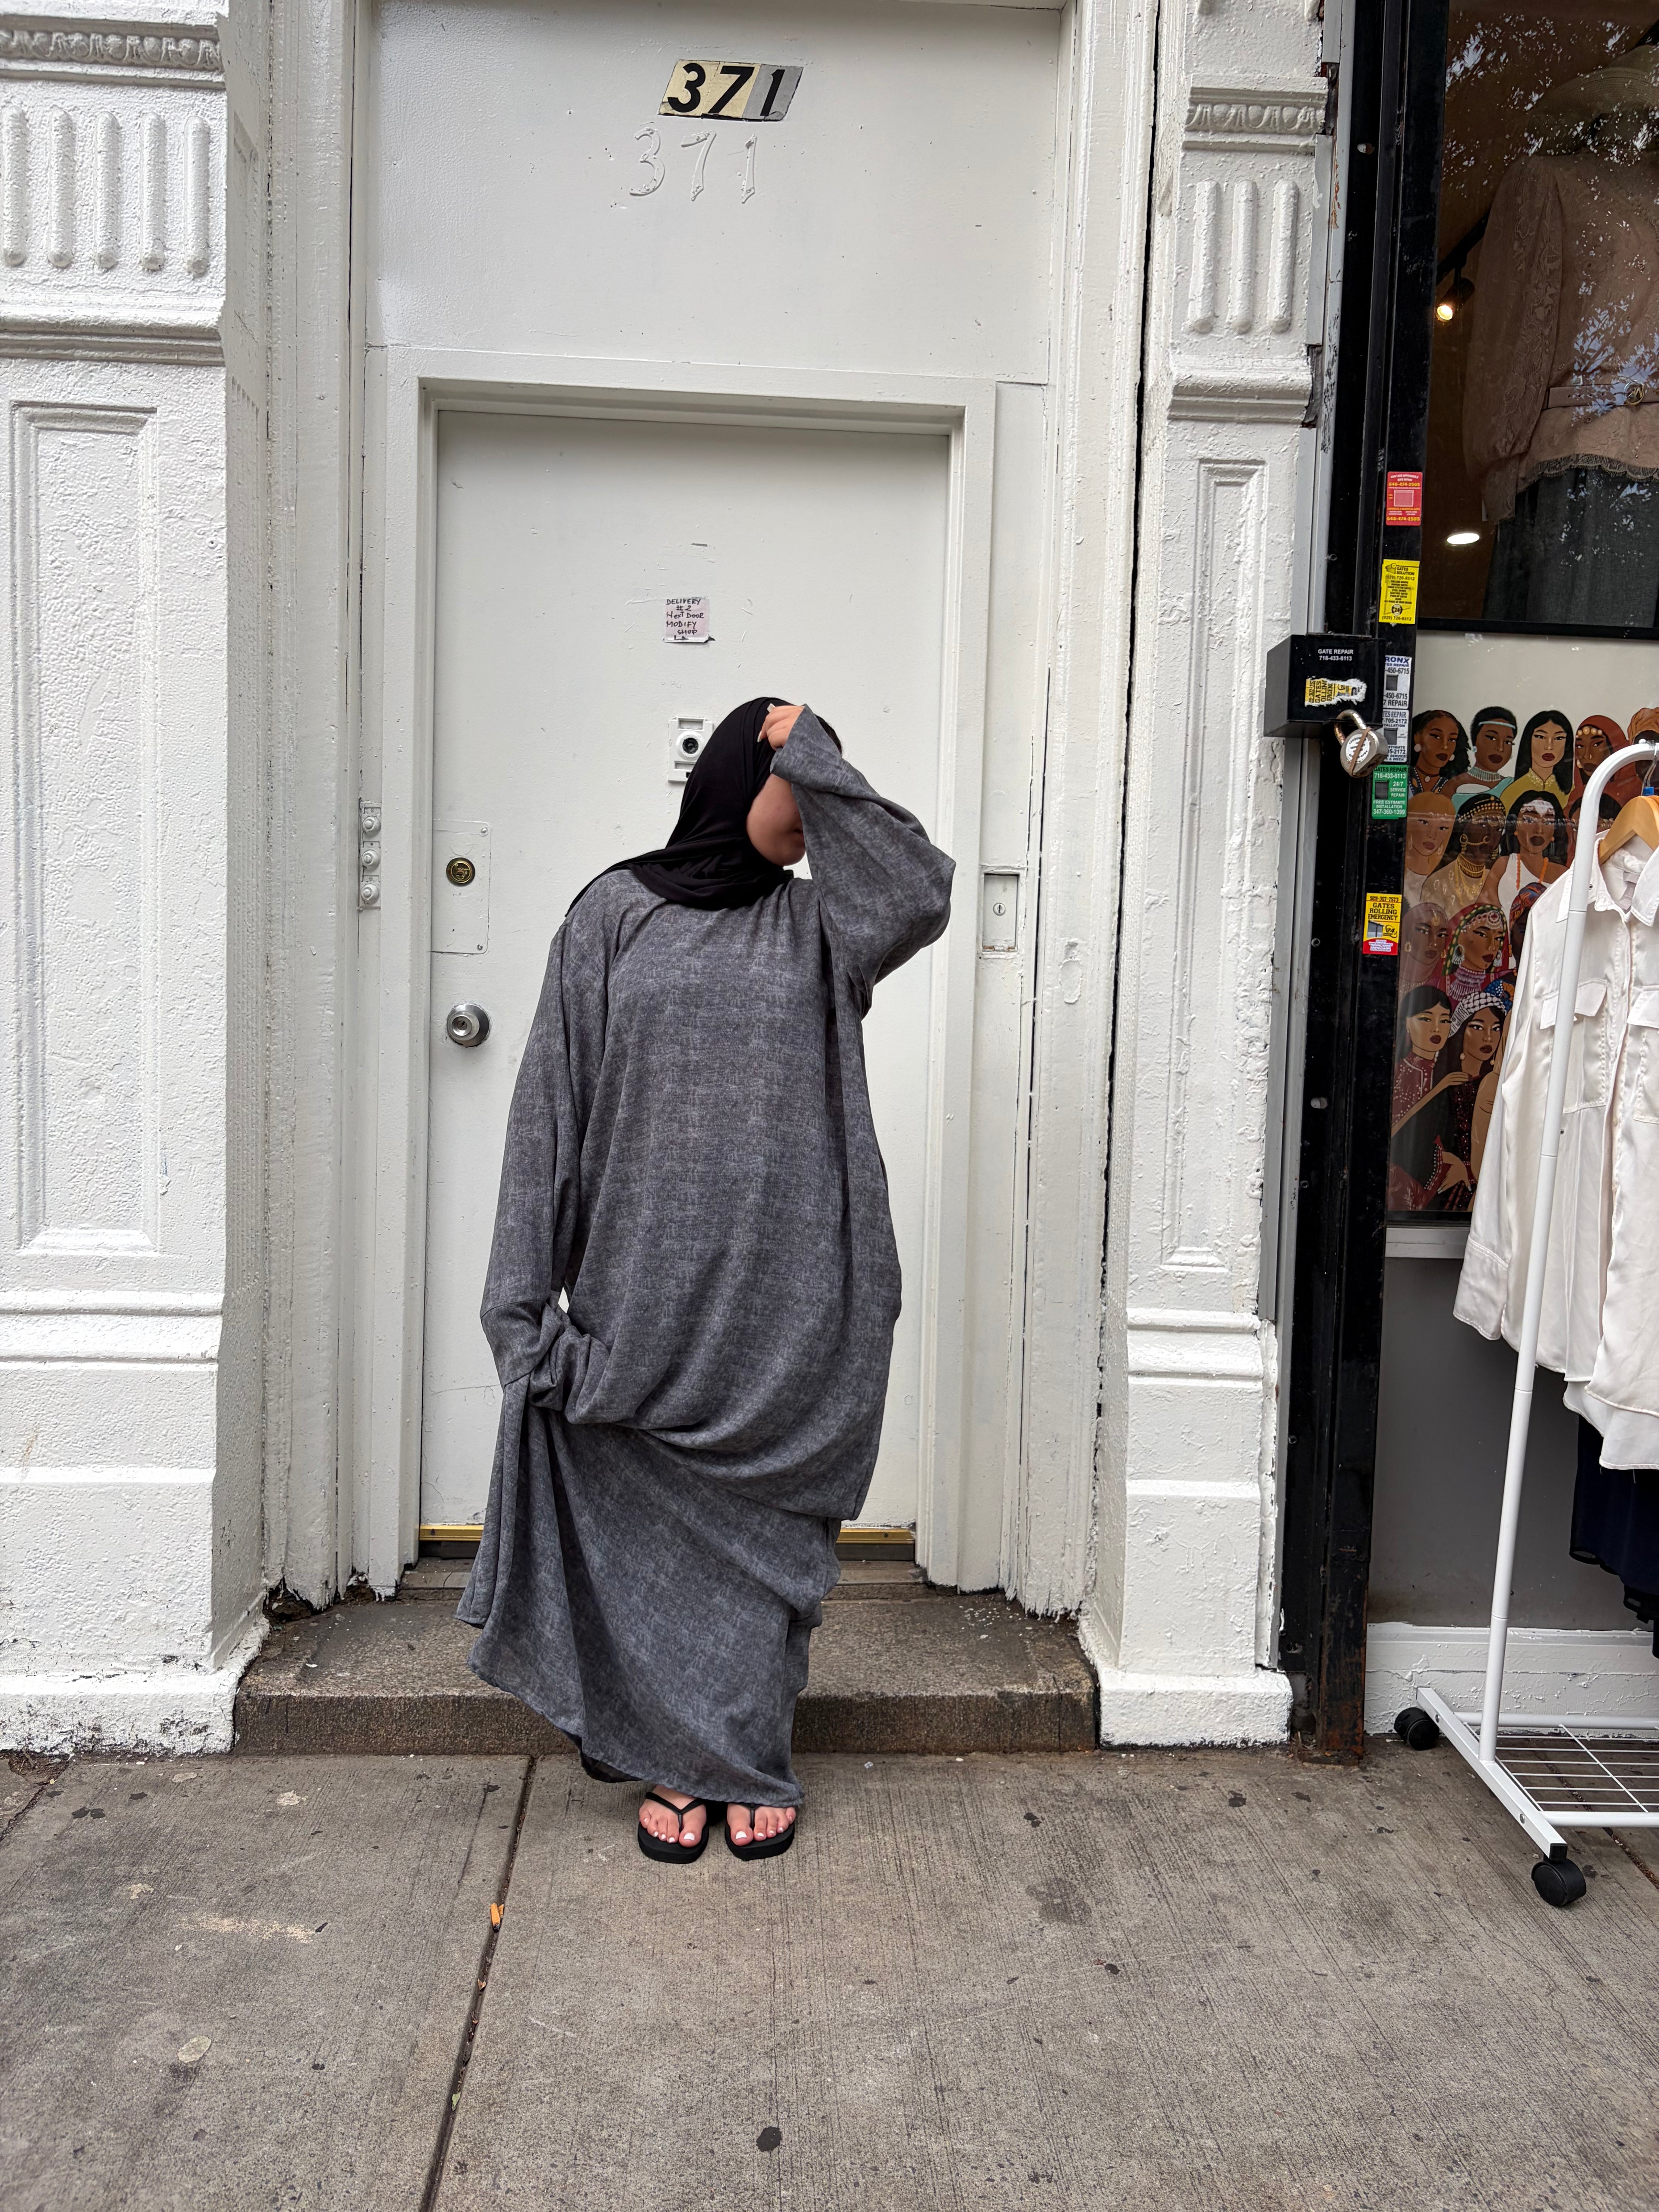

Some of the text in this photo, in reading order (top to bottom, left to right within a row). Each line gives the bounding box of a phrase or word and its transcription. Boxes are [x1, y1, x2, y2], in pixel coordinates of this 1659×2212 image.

[667, 63, 786, 117] 371
[630, 127, 757, 204] 371
[666, 620, 697, 629] MODIFY
